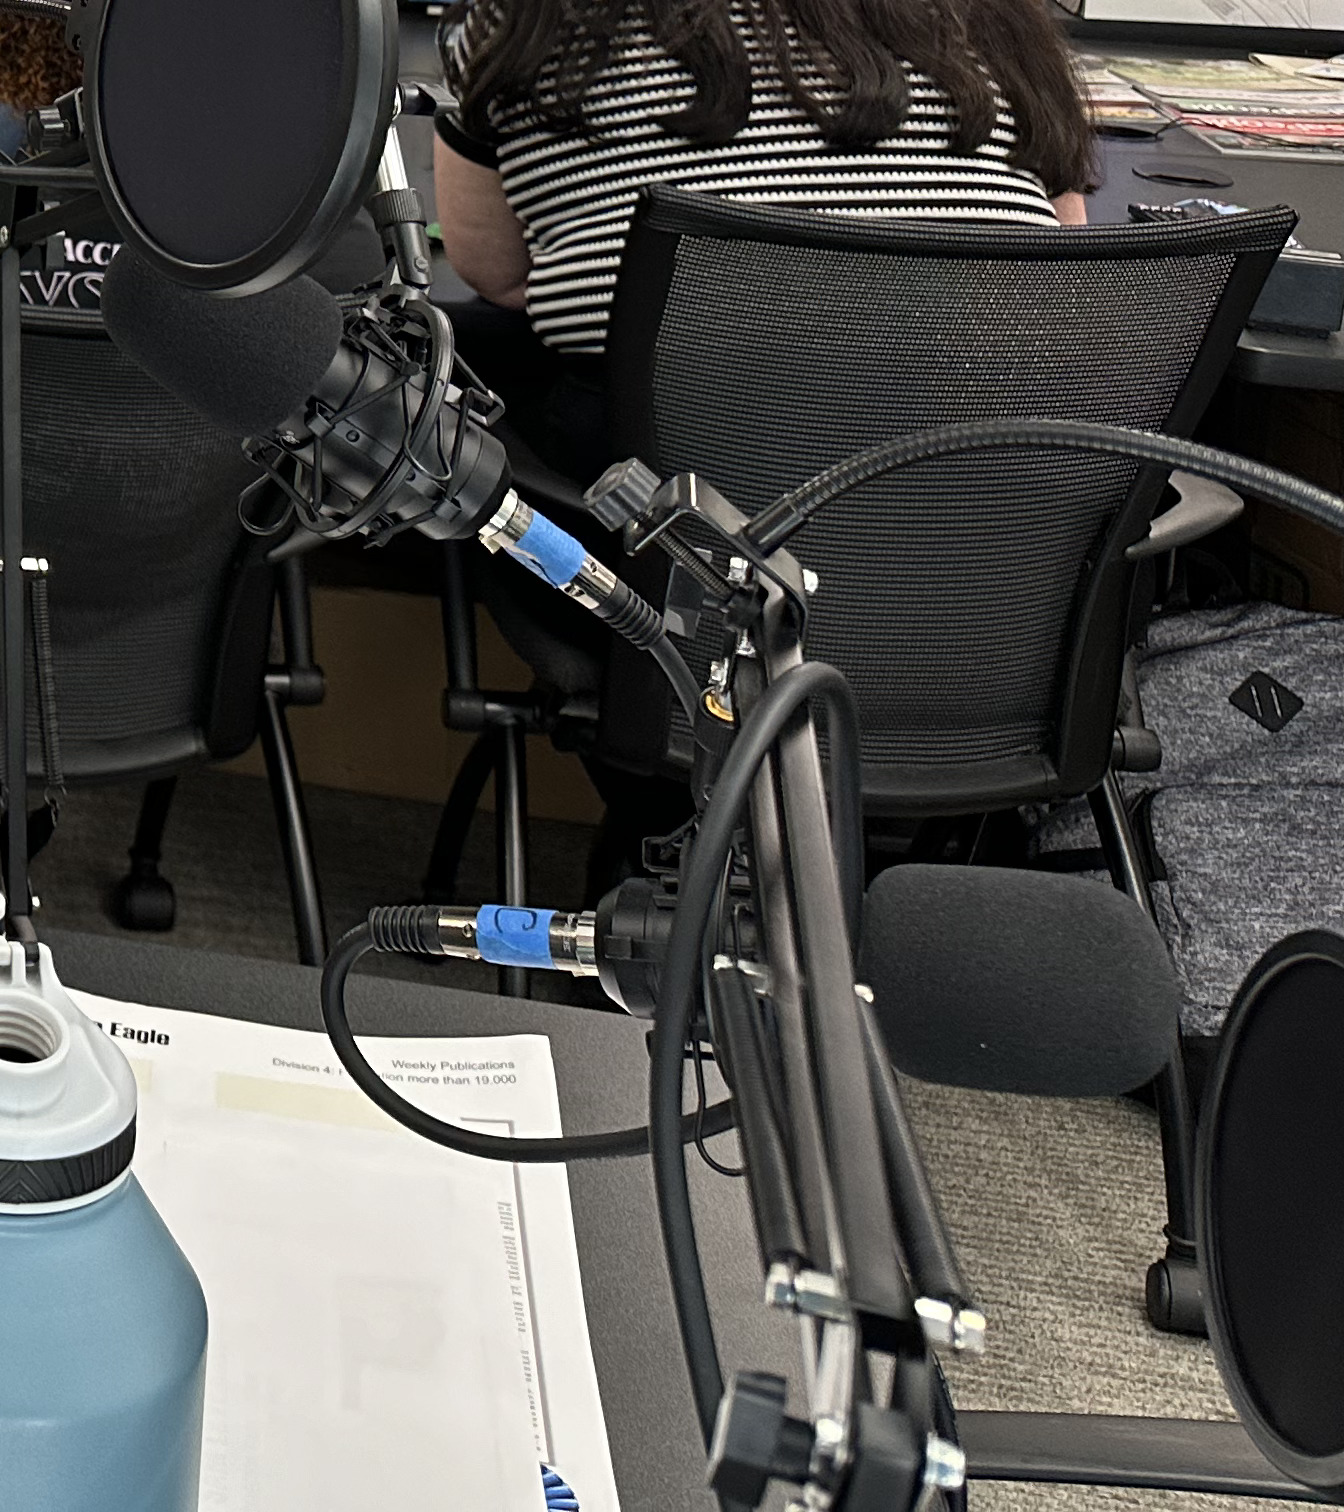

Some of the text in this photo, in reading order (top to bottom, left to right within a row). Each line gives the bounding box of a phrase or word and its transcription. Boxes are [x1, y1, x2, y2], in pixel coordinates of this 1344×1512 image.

[110, 1022, 171, 1046] Eagle
[272, 1057, 321, 1073] Division
[391, 1059, 516, 1072] Weekly Publications
[407, 1075, 439, 1085] more
[443, 1074, 471, 1085] than
